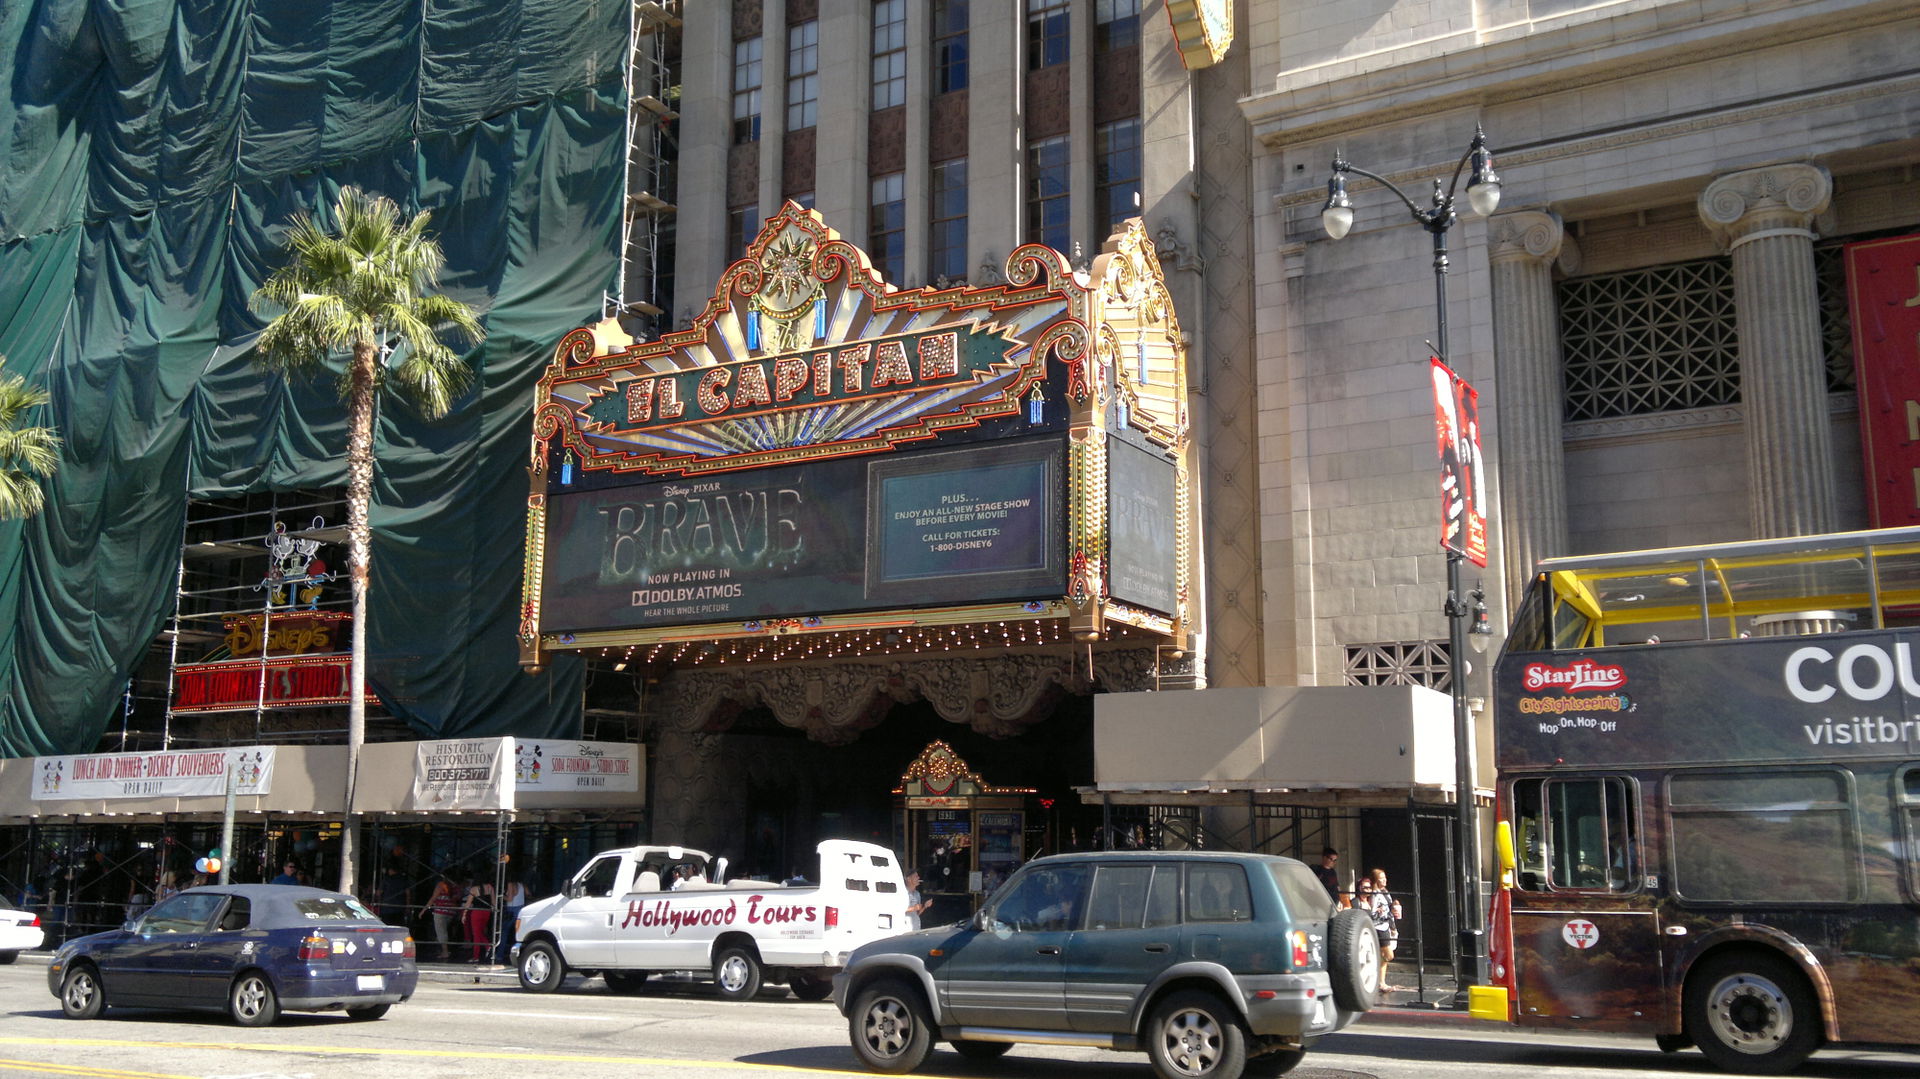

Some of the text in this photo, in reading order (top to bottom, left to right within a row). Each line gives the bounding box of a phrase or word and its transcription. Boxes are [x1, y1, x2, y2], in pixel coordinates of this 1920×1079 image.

[626, 331, 959, 423] EL CAPITAN
[663, 482, 721, 498] Disney PIXAR
[894, 498, 1031, 520] ENJOY AN ALL-NEW STAGE SHOW
[916, 510, 1008, 526] BEFORE EVERY MOVIE!
[599, 488, 802, 575] BRAVE
[922, 528, 1000, 542] CALL FOR TICKETS:
[930, 540, 993, 552] 1-800-DISNEY6
[648, 568, 731, 585] NOW PLAYING IN
[651, 583, 742, 604] DOLBY ATMOS
[644, 603, 729, 617] HEAR THE WHOLE PICTURE
[177, 674, 206, 706] SODA
[287, 664, 343, 699] STUDIO
[436, 742, 484, 755] HISTORIC
[72, 752, 226, 780] LUNCH AND DINNER DISNEY SOUVENIERS
[425, 753, 494, 766] RESTORATION
[552, 758, 629, 774] SODA FOUNTAIN STUDIO STORE
[123, 781, 163, 794] OPEN DAILY
[577, 777, 605, 787] OPEN DAILY
[621, 894, 817, 936] Hollywood Tours
